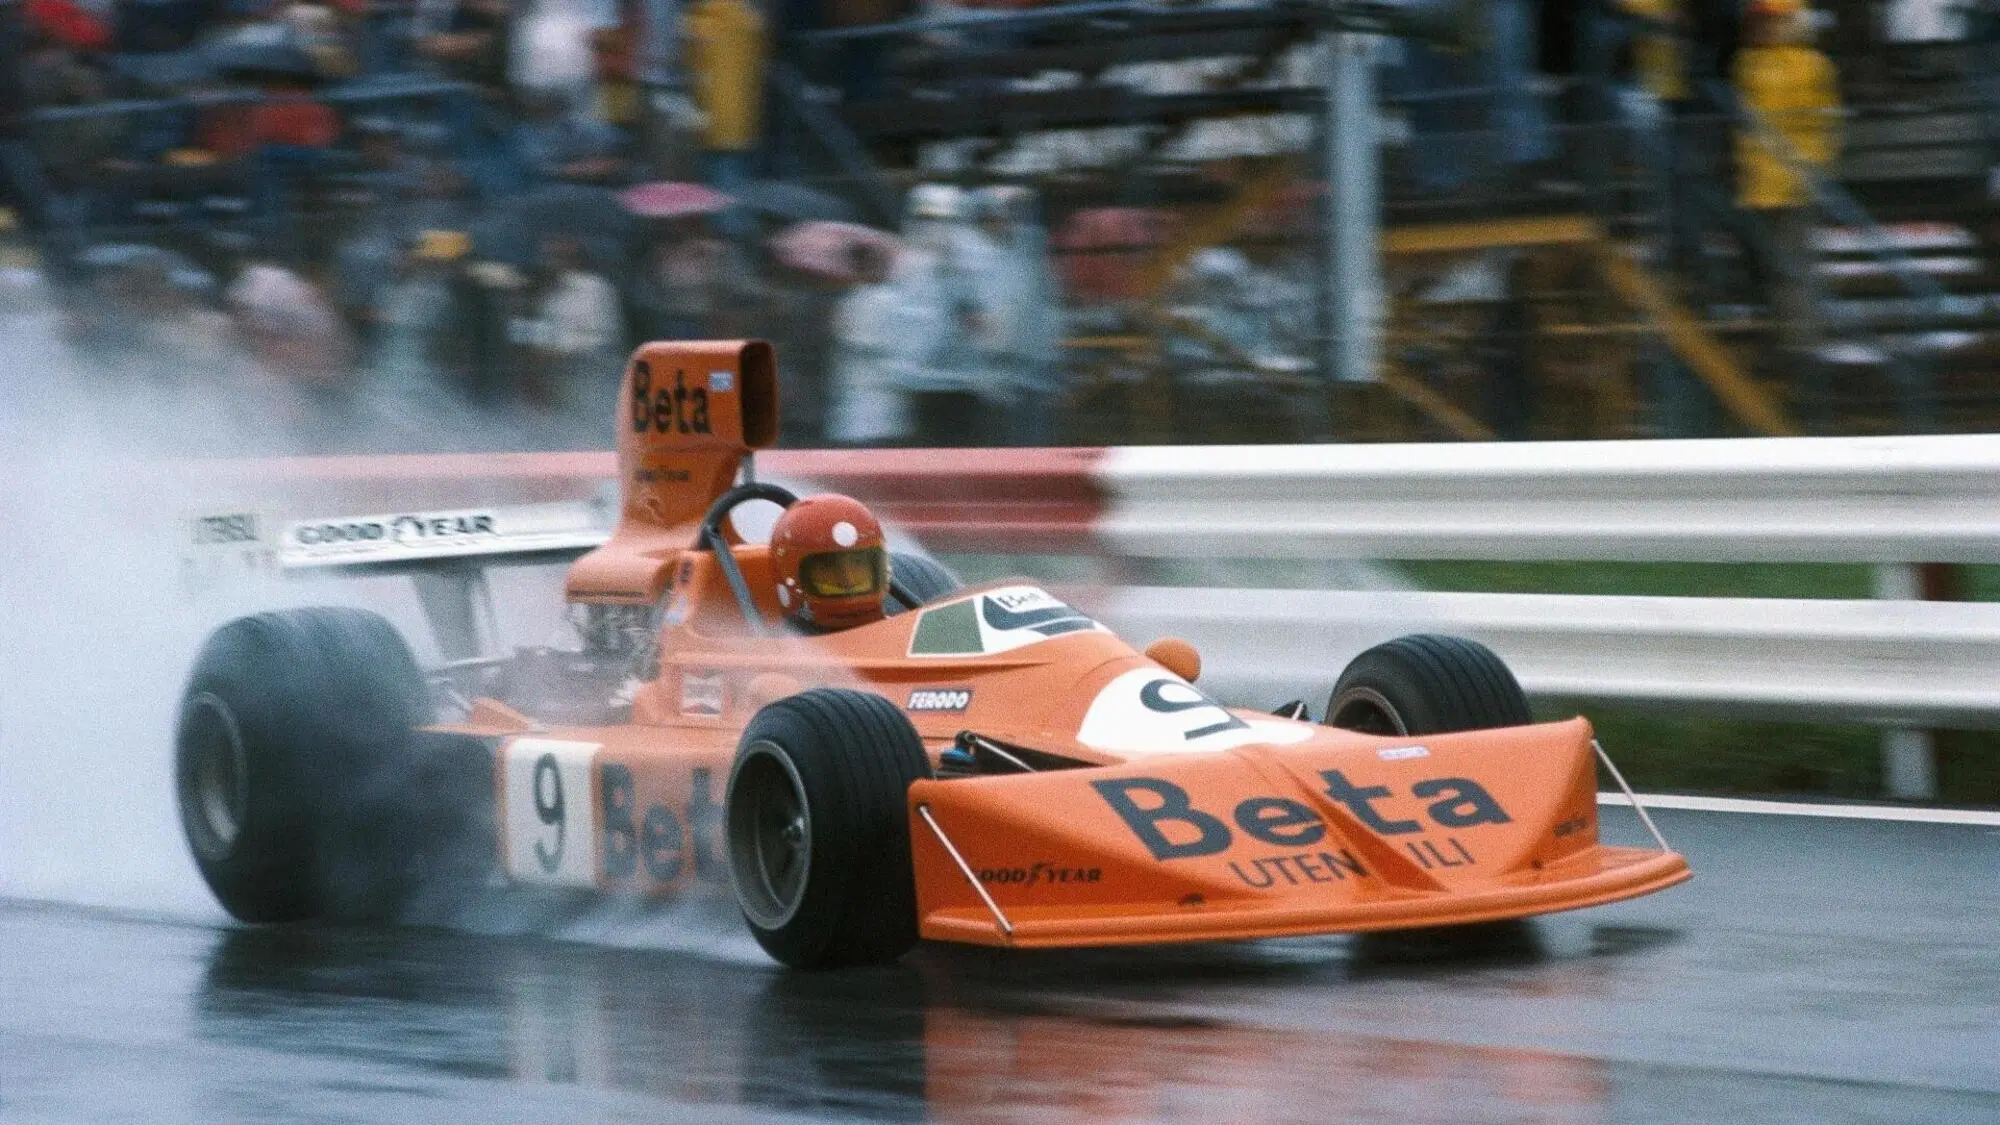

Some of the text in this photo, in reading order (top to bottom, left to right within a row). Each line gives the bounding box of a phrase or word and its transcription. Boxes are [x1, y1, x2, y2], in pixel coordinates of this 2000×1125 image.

[633, 359, 711, 434] Beta
[907, 689, 970, 711] FERODO
[533, 752, 565, 873] 9
[1089, 769, 1512, 862] Beta
